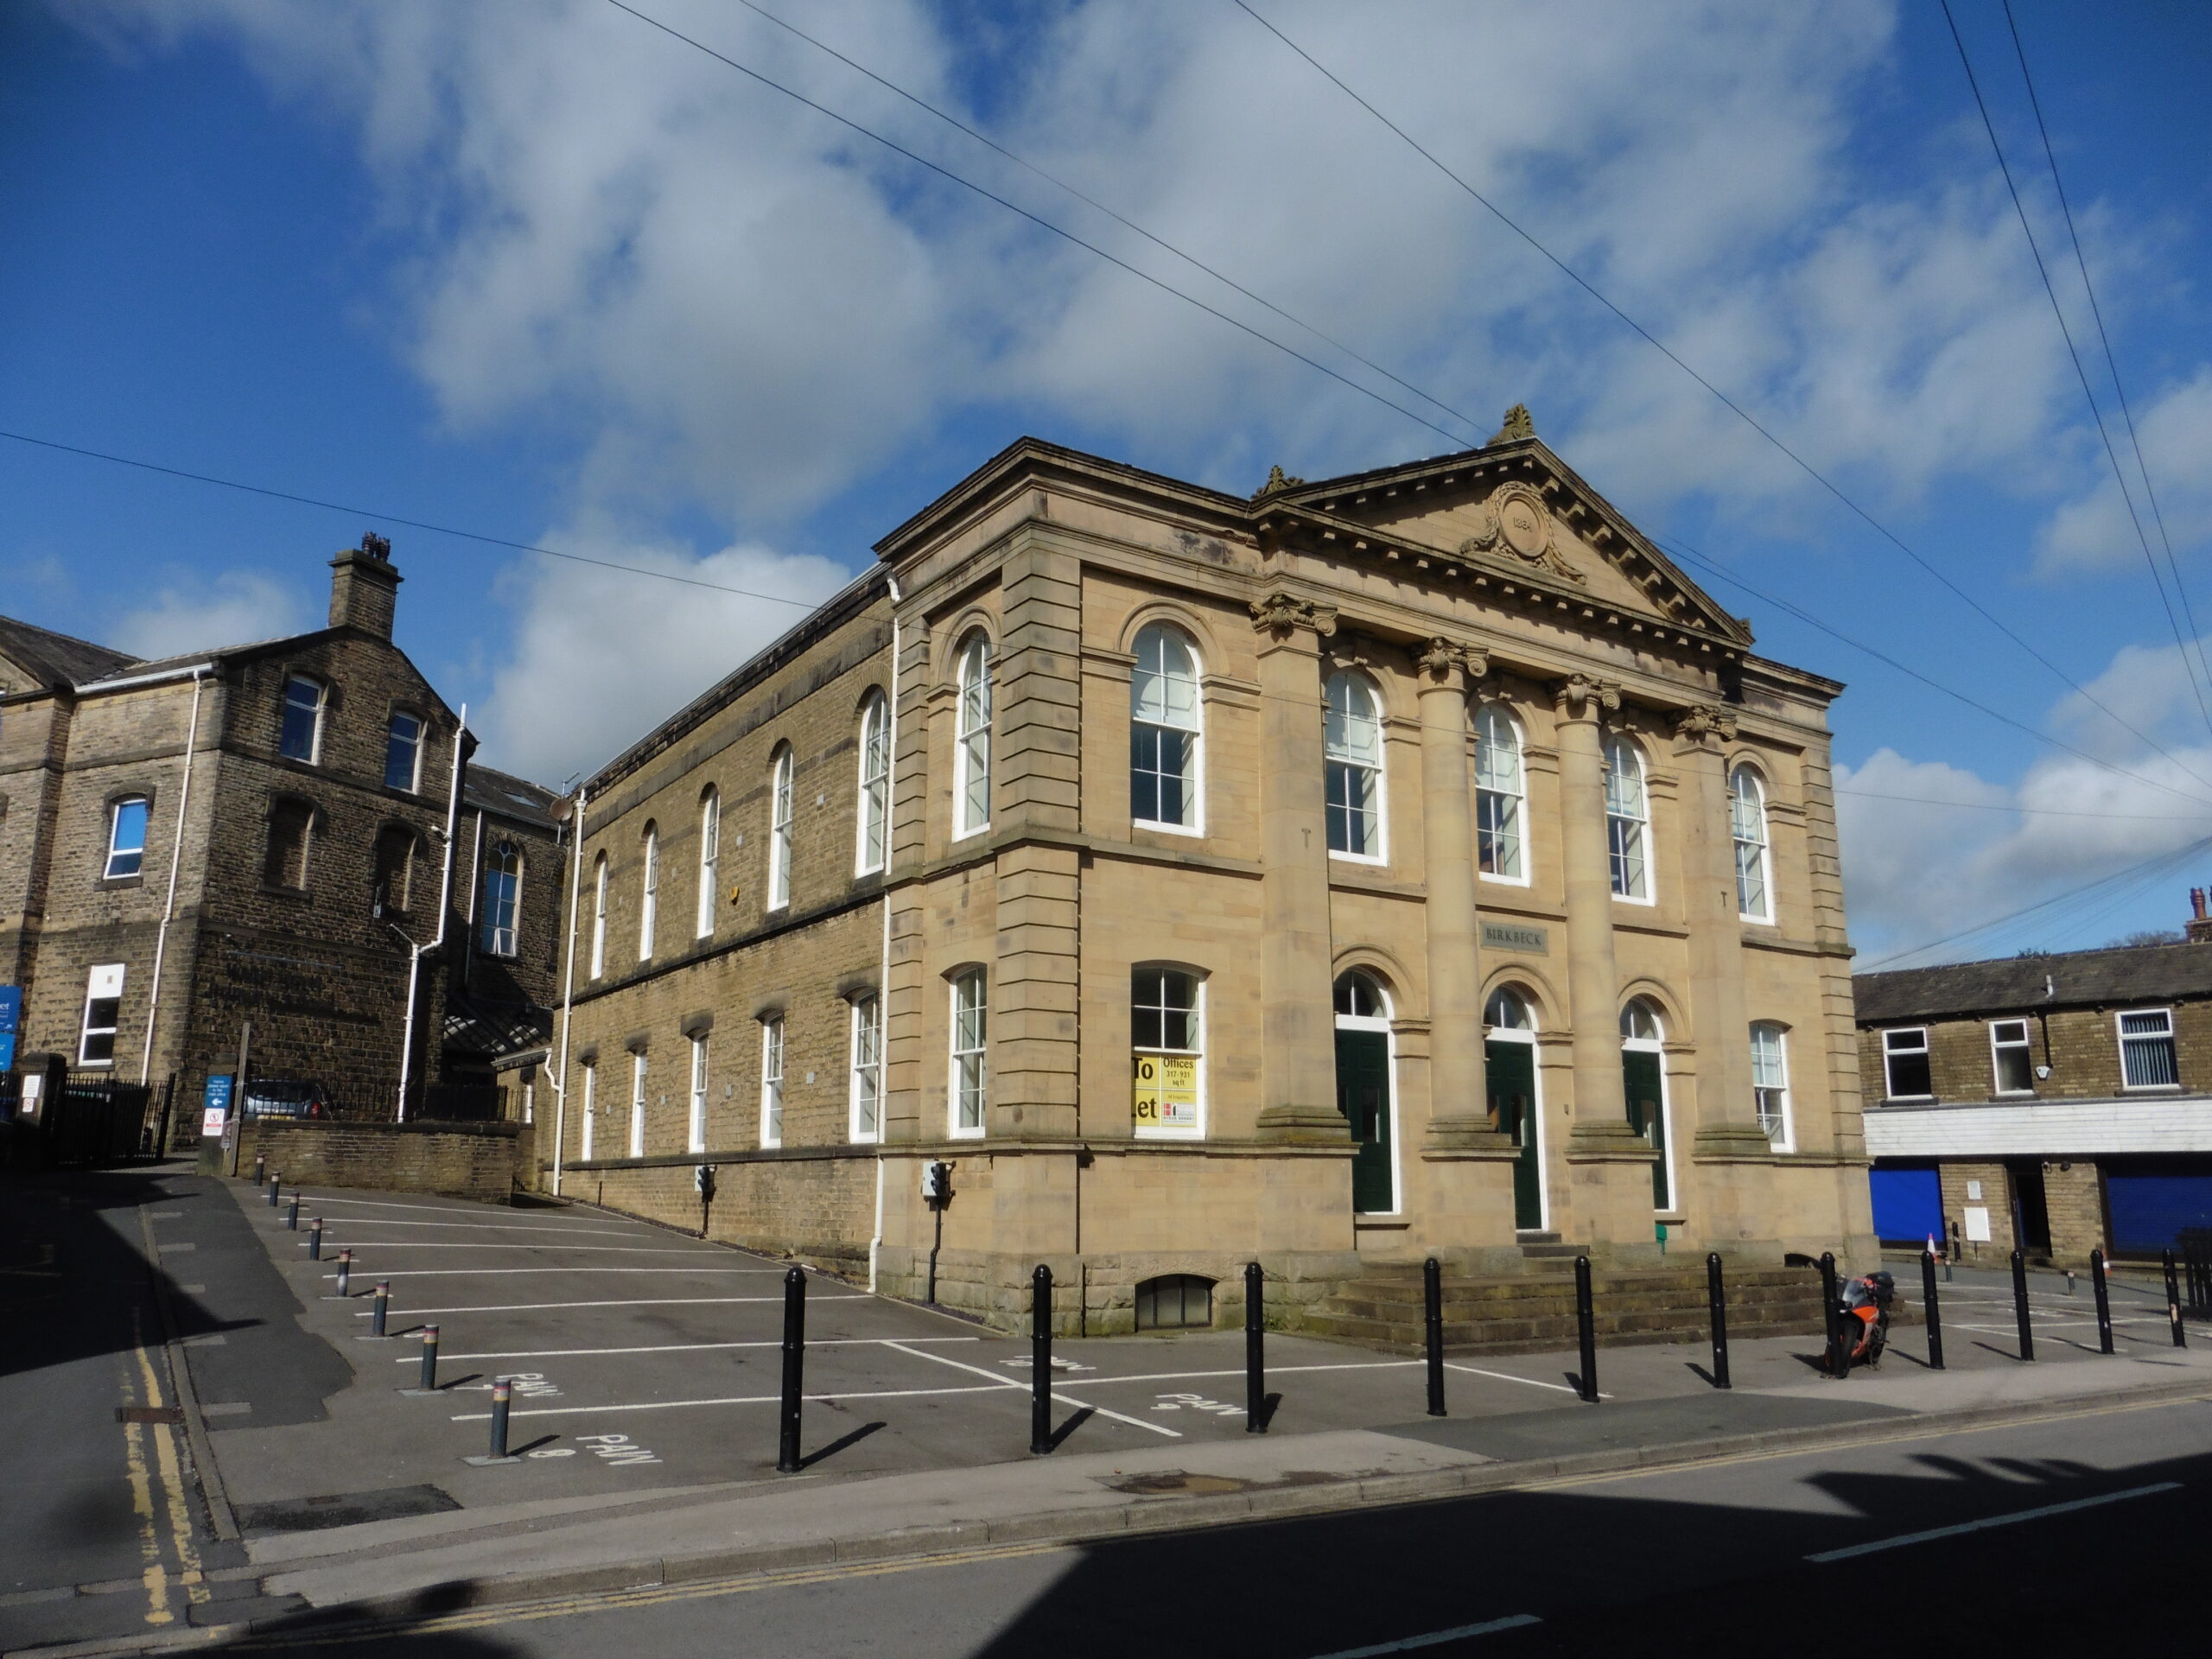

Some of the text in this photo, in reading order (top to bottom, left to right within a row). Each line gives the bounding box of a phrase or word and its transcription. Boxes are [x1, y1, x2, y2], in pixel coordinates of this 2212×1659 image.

[1486, 928, 1542, 946] BIRKBECK
[1131, 1057, 1154, 1079] To
[1163, 1057, 1193, 1069] Offices
[1131, 1098, 1156, 1118] et
[1154, 1393, 1249, 1415] PAW
[528, 1448, 576, 1459] 8
[575, 1434, 664, 1465] PAW
